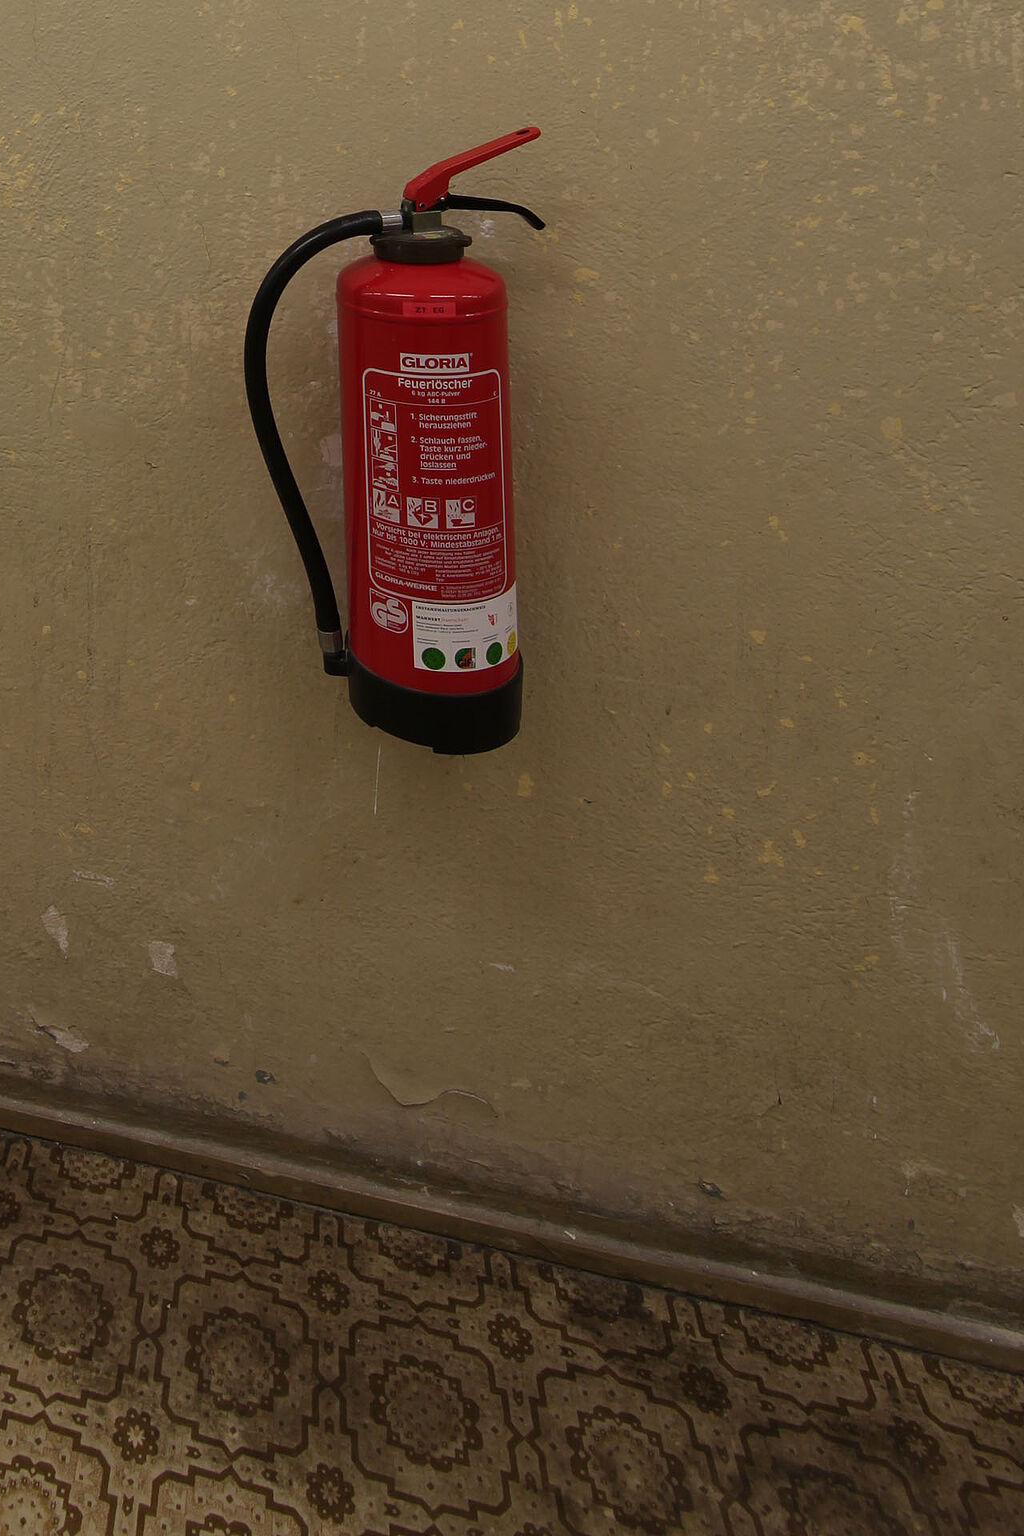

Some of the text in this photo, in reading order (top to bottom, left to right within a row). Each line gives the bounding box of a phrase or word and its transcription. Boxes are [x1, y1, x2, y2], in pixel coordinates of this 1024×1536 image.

[401, 356, 468, 369] GLORIA
[398, 377, 473, 390] Feuerlöscher
[419, 411, 478, 422] Sicherungsstift
[419, 421, 472, 429] herausziehen
[420, 436, 456, 444] Schlauch
[420, 442, 488, 453] Taste kurz nieder-
[420, 452, 471, 461] drücken und
[420, 460, 457, 469] loslassen
[421, 477, 443, 485] Taste
[445, 471, 496, 485] niederdrücken
[387, 494, 400, 507] A
[424, 500, 437, 513] B
[462, 499, 475, 512] C
[376, 521, 406, 536] Vorsicht
[408, 530, 421, 539] bei
[423, 532, 472, 541] elektrischen
[372, 527, 385, 538] Nur
[387, 532, 397, 542] bis
[399, 536, 419, 547] 1000
[420, 540, 429, 549] V:
[430, 536, 490, 549] Mindestabstand
[375, 571, 438, 592] GLORIA-WERKE
[371, 598, 407, 628] GS
